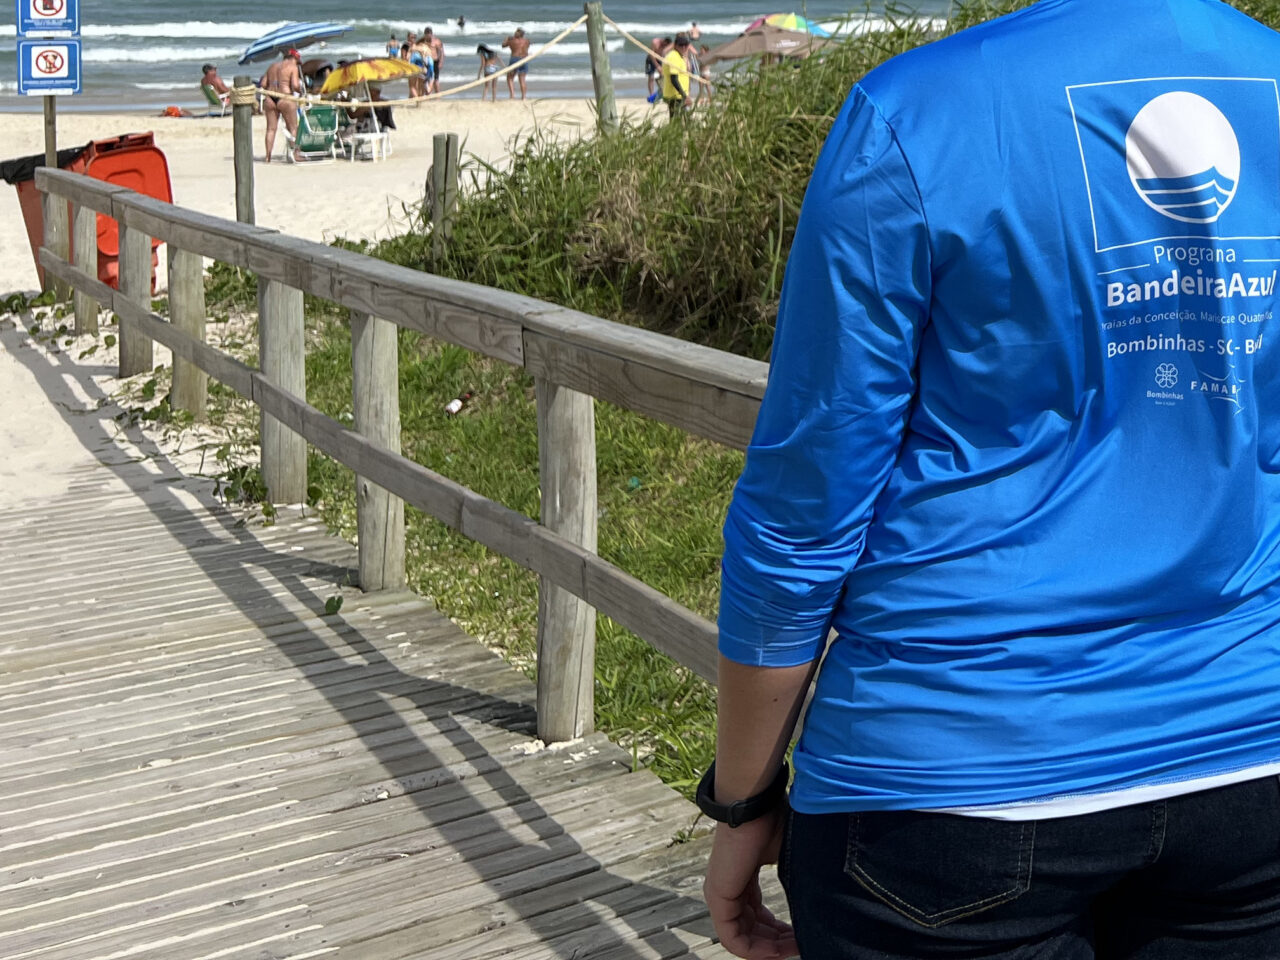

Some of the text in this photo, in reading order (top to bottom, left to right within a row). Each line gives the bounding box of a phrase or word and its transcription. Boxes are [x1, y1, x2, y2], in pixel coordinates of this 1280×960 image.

[1128, 315, 1142, 325] da
[1107, 334, 1205, 358] Bombinhas
[1146, 390, 1184, 401] Bombinhas
